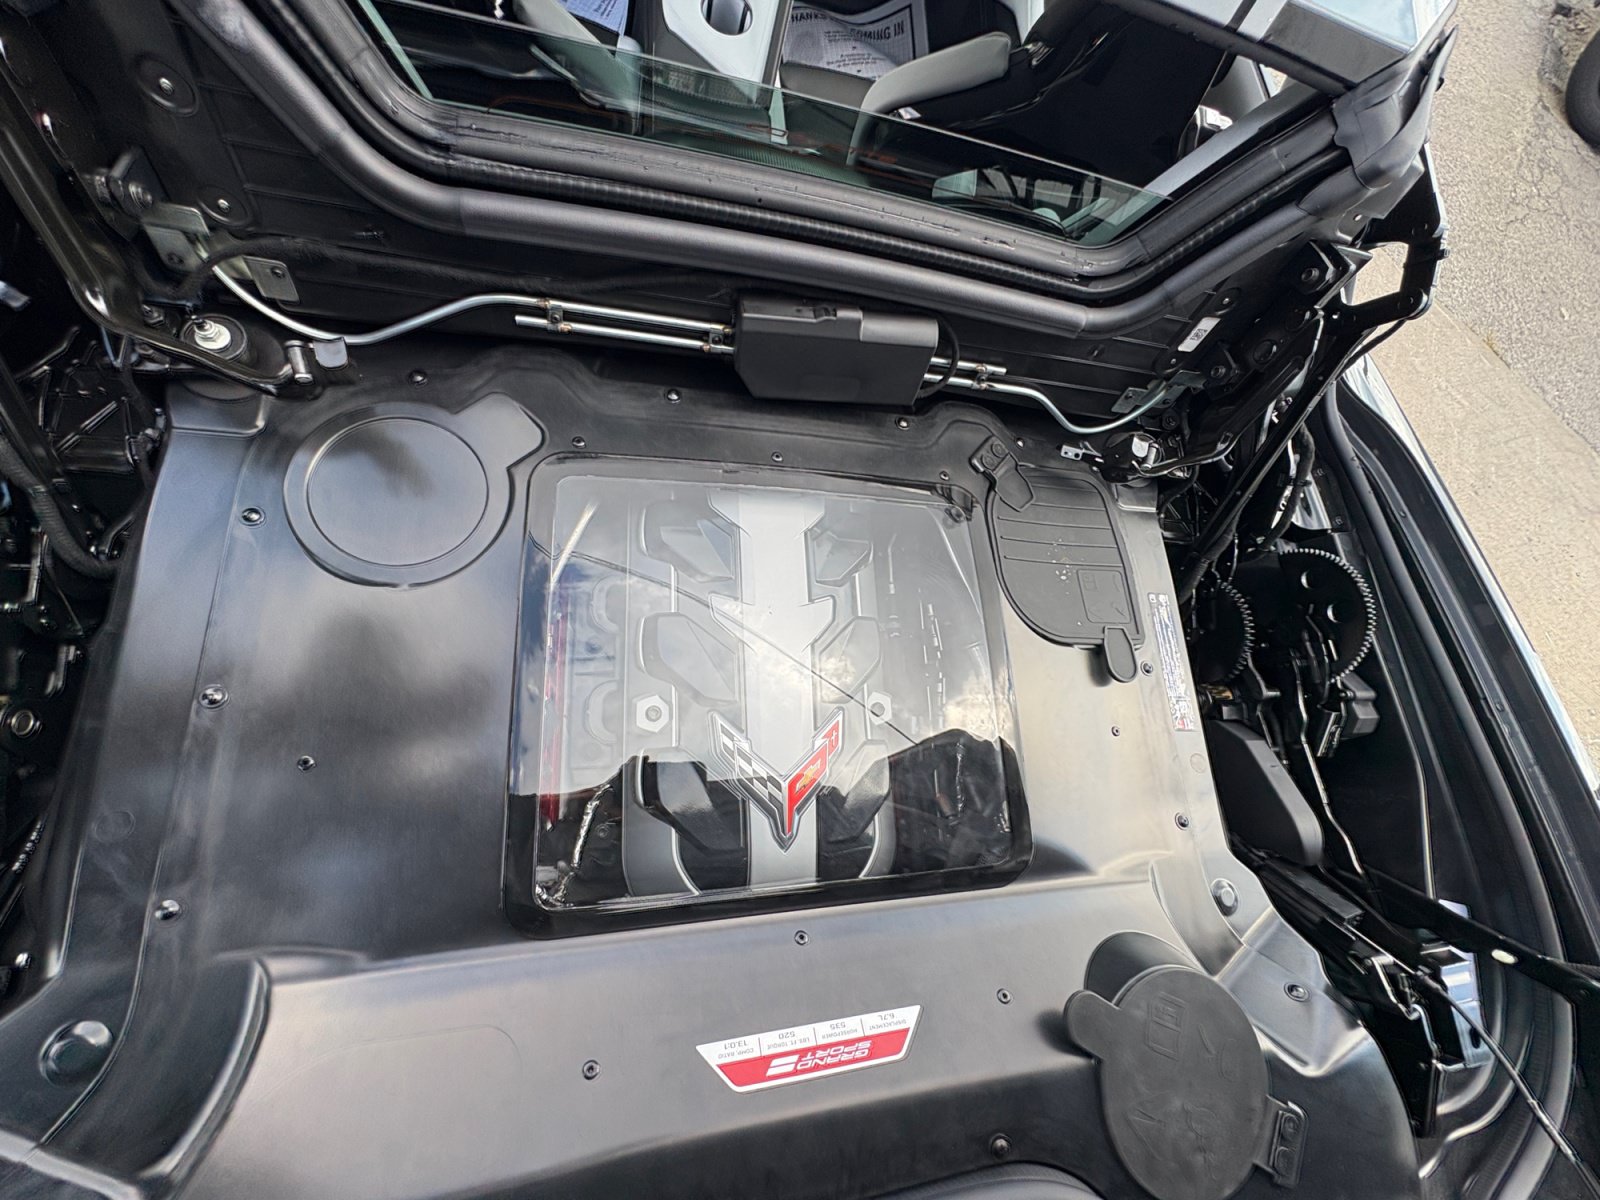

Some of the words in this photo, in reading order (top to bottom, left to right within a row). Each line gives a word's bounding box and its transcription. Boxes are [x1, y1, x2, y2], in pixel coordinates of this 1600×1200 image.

[894, 20, 904, 37] IN
[829, 1021, 847, 1031] 535
[868, 1019, 907, 1031] DISPLACEMENT
[777, 1030, 796, 1040] 520
[723, 1040, 749, 1050] 13.0:1
[801, 1040, 872, 1061] SPORT
[717, 1050, 735, 1059] RATIO
[797, 1049, 869, 1069] GRAND
